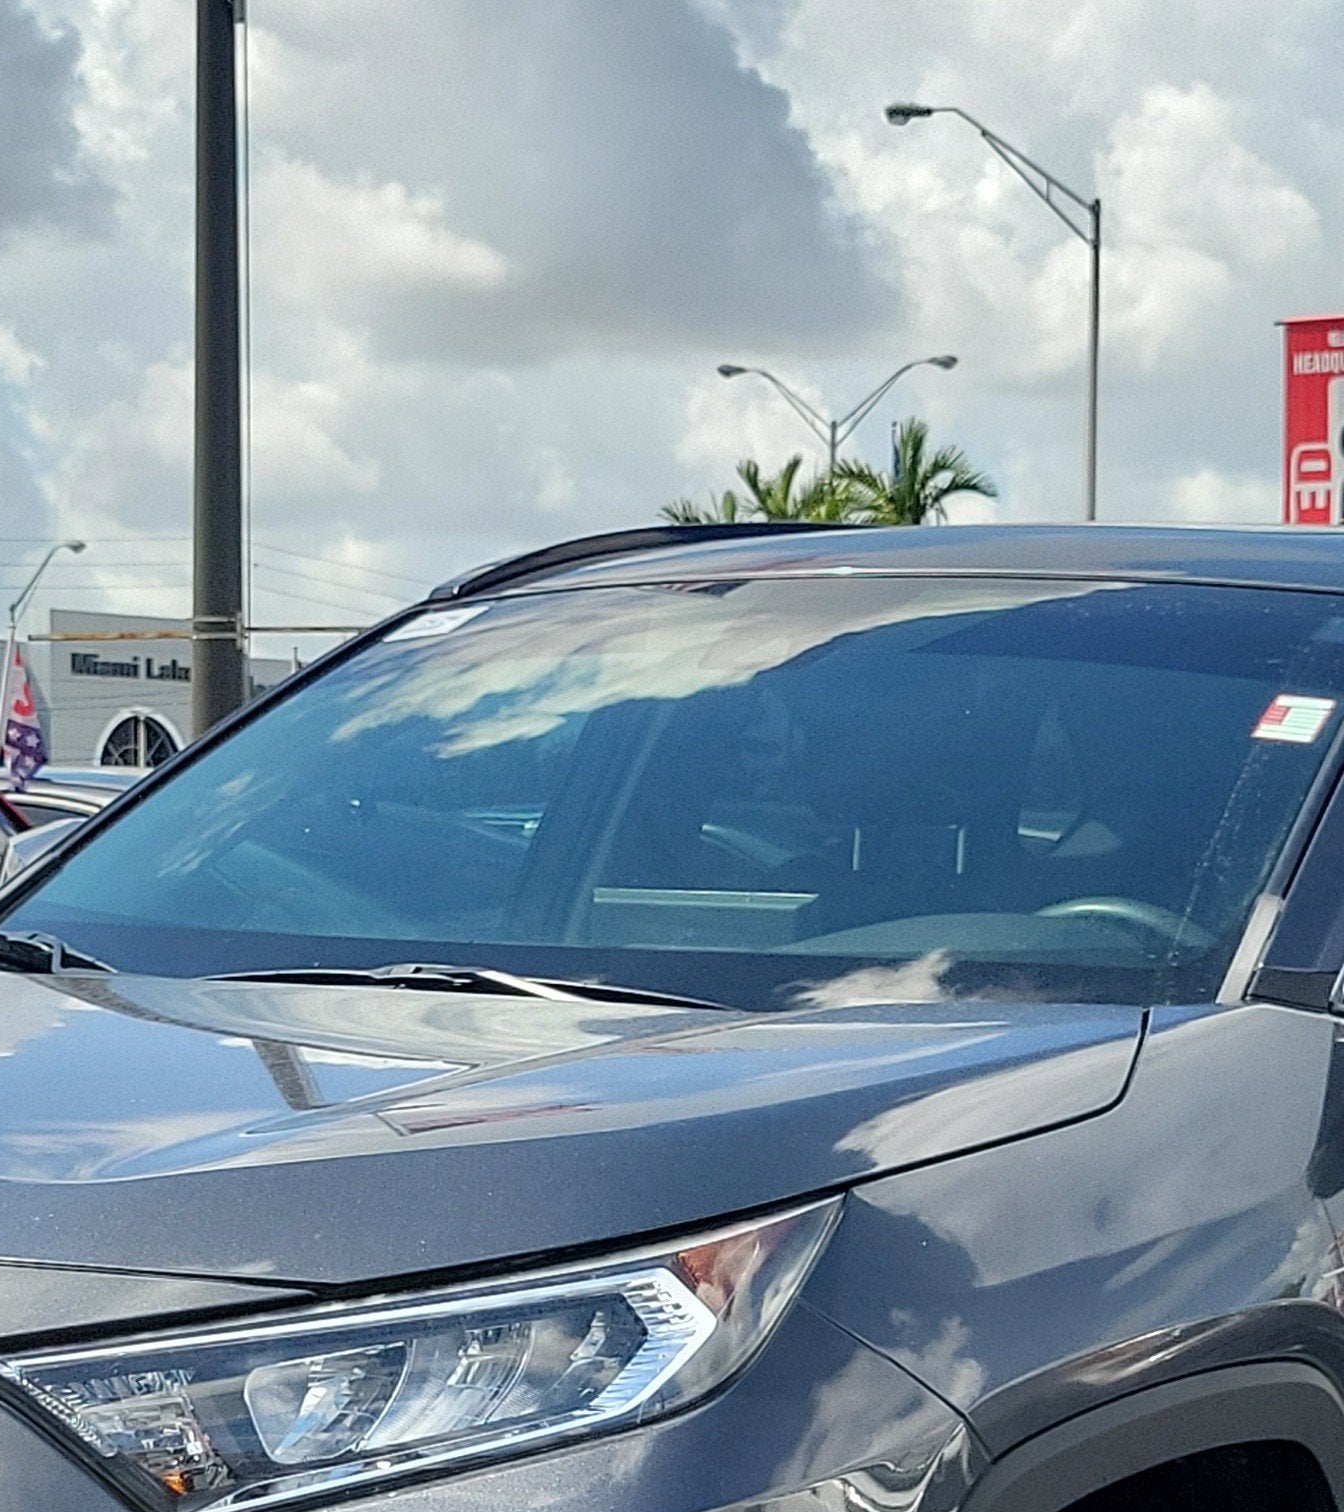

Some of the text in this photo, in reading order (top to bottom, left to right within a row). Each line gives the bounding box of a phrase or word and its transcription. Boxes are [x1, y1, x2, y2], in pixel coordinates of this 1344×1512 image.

[1296, 449, 1332, 524] ED
[71, 652, 191, 683] Miami Lake
